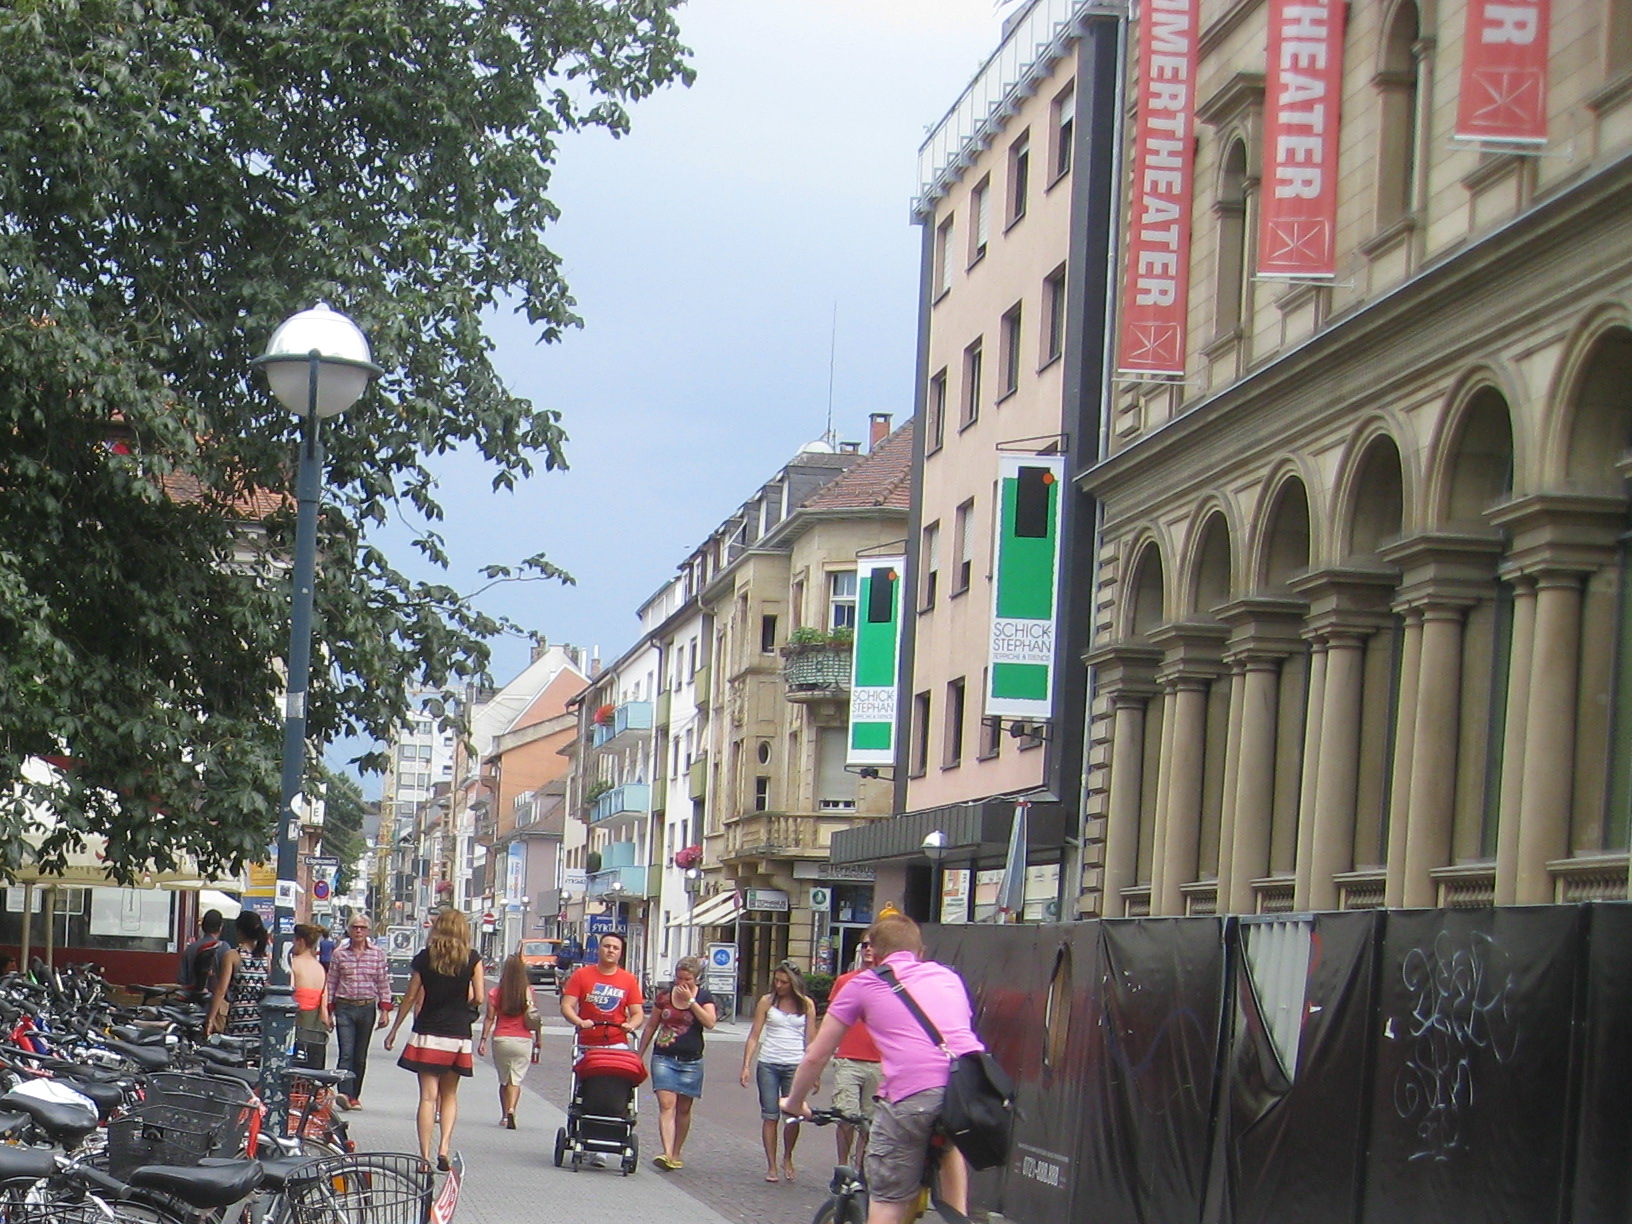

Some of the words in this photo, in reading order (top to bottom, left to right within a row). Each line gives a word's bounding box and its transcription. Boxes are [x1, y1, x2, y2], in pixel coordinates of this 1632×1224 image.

[1481, 0, 1536, 45] R
[1275, 0, 1328, 199] HEATER
[993, 638, 1051, 652] STEPHAN
[852, 703, 894, 712] STEPHAN
